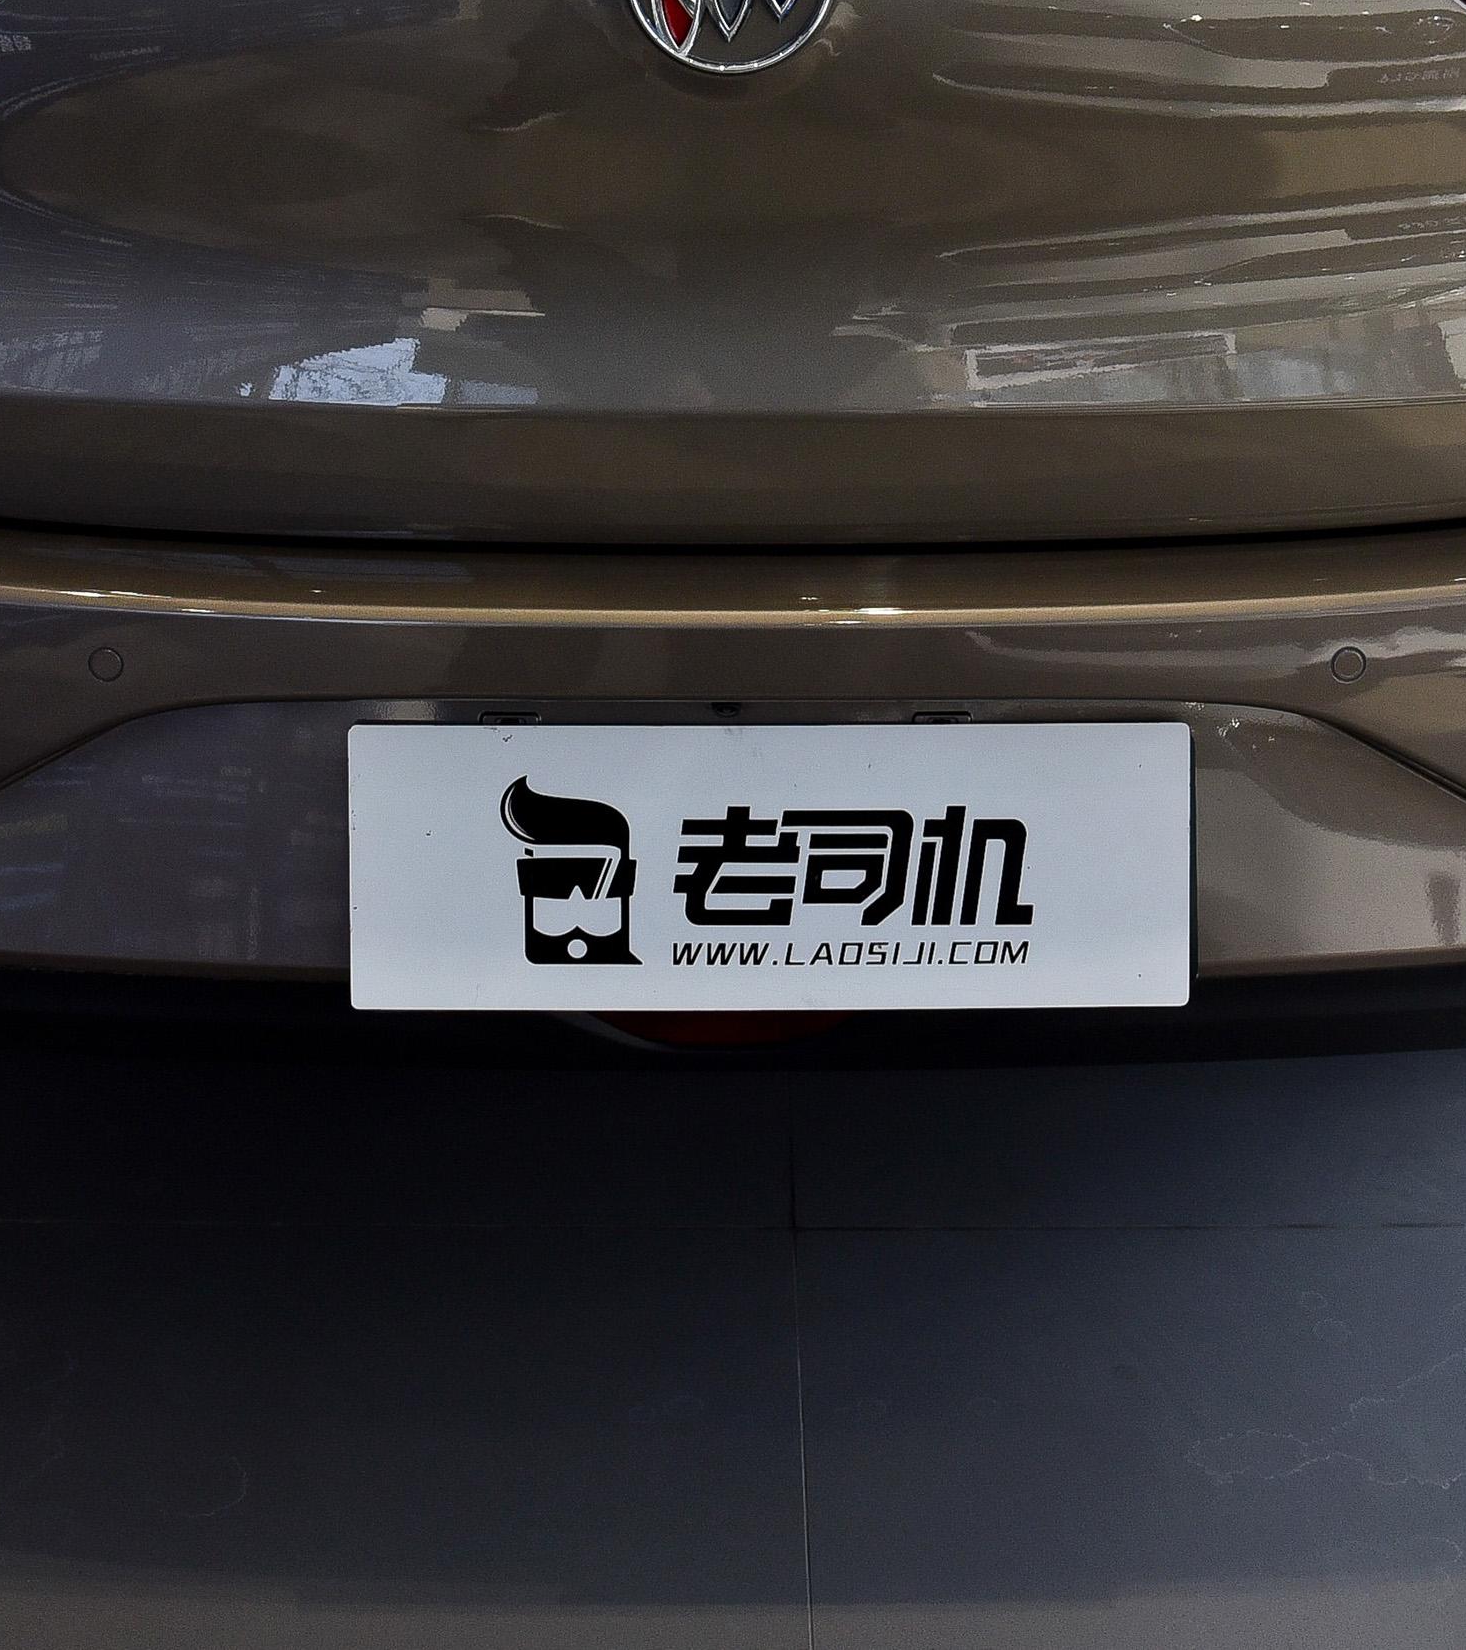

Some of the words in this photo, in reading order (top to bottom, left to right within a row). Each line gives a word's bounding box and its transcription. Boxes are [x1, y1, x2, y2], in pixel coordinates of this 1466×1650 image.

[673, 806, 1034, 926] 老司机
[672, 939, 1030, 966] WWW.LAOSIJI.COM
